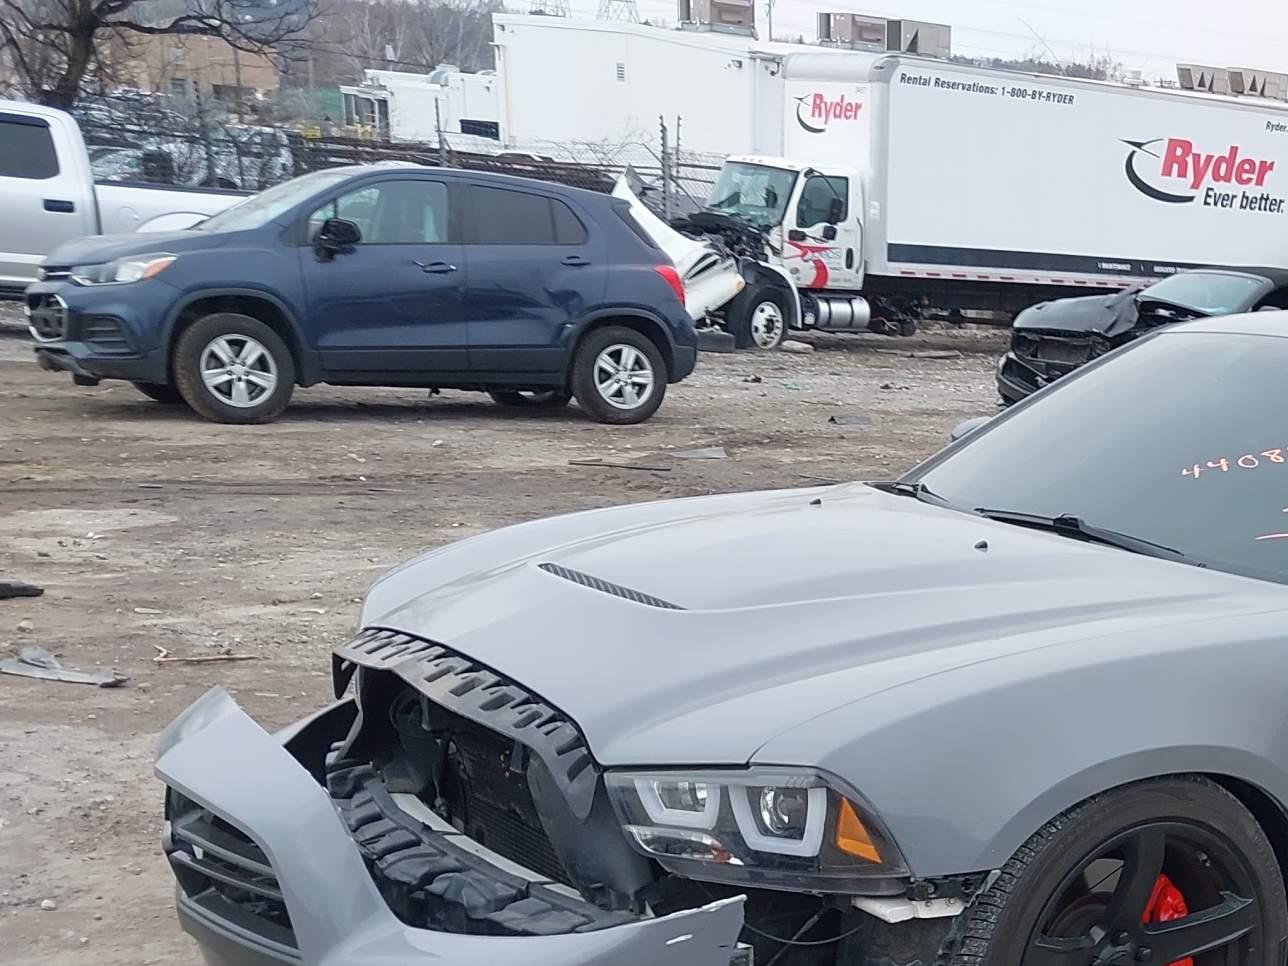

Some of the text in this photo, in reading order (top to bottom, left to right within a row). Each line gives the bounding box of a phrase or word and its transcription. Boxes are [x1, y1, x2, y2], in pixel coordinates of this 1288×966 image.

[900, 73, 1075, 106] Rental Reservations: 1-800-BY-RYDER
[811, 93, 862, 125] Ryder
[1161, 138, 1275, 190] Ryder
[1203, 187, 1285, 214] Ever better.
